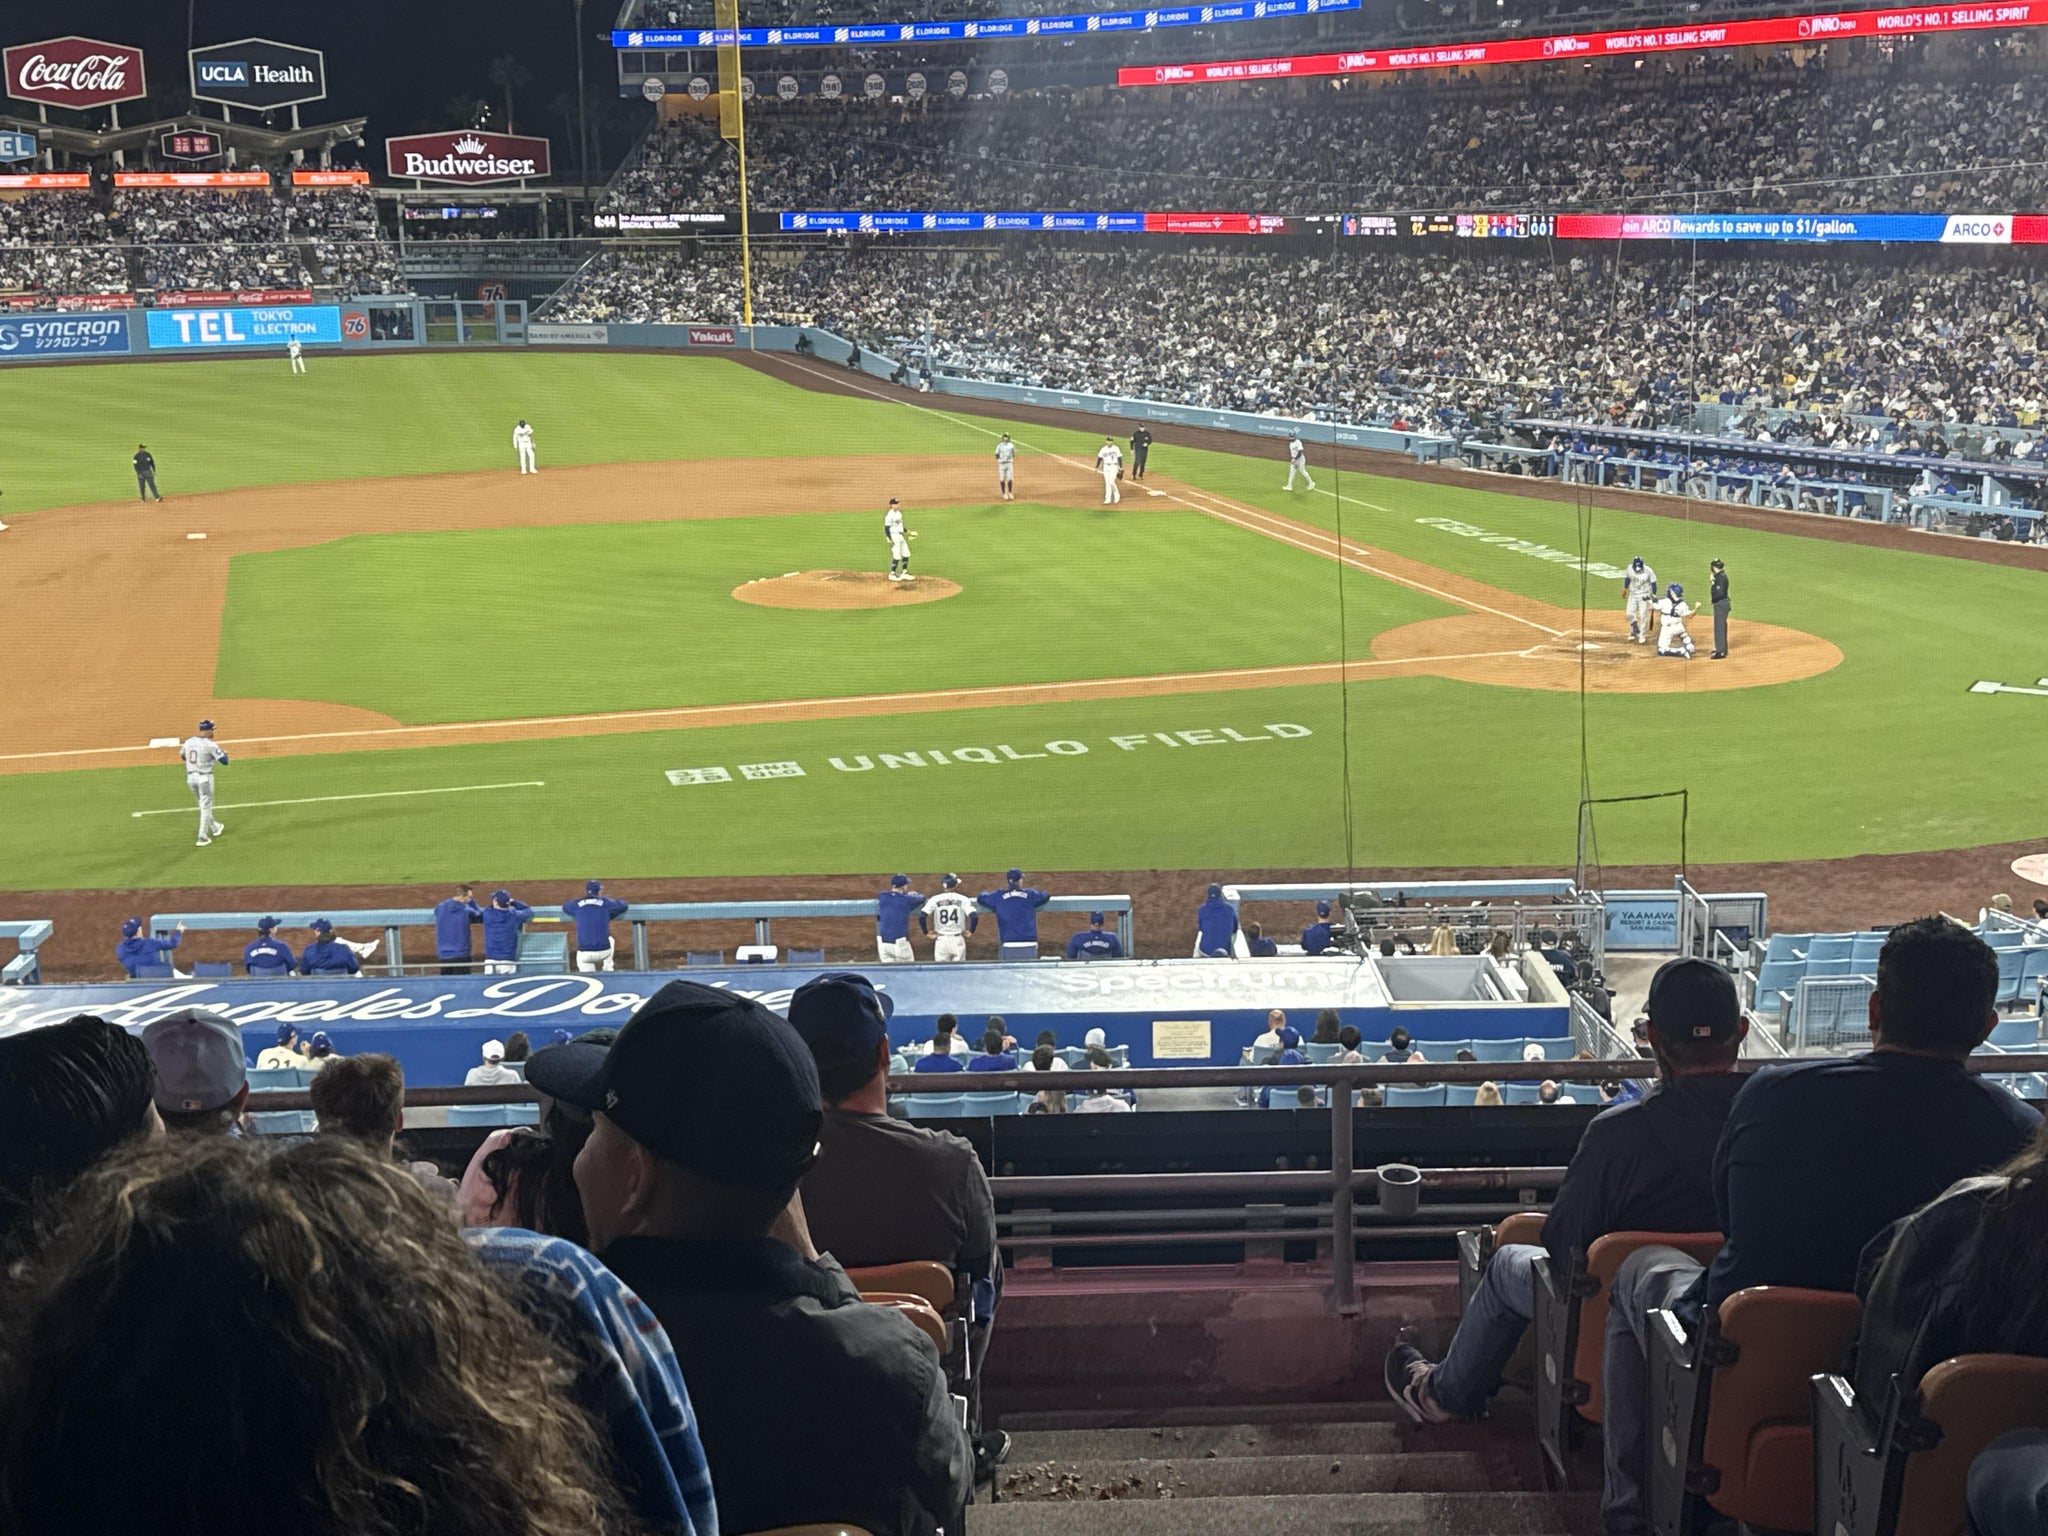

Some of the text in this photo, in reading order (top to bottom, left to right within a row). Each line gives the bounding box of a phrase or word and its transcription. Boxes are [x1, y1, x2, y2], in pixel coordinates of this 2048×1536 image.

[645, 34, 682, 42] ELDRIDGE
[851, 30, 886, 38] ELDRIDGE
[916, 27, 950, 36] ELDRIDGE
[980, 24, 1013, 33] ELDRIDGE
[1042, 21, 1074, 30] ELDRIDGE
[1101, 17, 1132, 26] ELDRIDGE
[1214, 7, 1243, 17] ELDRIDGE
[1877, 14, 1922, 29] WORLD'S
[1951, 9, 1993, 24] SELLING
[1995, 6, 2030, 21] SPIRIT
[19, 54, 129, 91] Coca-Cola
[201, 65, 314, 83] UCLA Health
[821, 81, 840, 91] 1981
[809, 217, 844, 225] ELDRIDGE
[875, 217, 908, 225] ELDRIDGE
[938, 217, 970, 225] ELDRIDGE
[998, 217, 1030, 226] ELDRIDGE
[1056, 218, 1085, 226] ELDRIDGE
[1642, 220, 1671, 233] ARCO
[1673, 220, 1720, 233] Rewards
[1723, 221, 1733, 233] to
[1736, 223, 1762, 233] save
[1765, 223, 1779, 236] up
[1782, 221, 1793, 233] to
[1796, 219, 1857, 237] $1/gallon.
[1953, 223, 1991, 236] ARCO
[252, 310, 293, 321] TOKYO
[20, 320, 120, 338] SYNCRON
[172, 312, 246, 343] TEL
[254, 323, 317, 335] ELECTRON
[347, 318, 365, 334] 76
[691, 331, 734, 343] Yakult
[828, 723, 1313, 772] UNIQLO FIELD
[939, 908, 959, 925] 84
[1061, 970, 1332, 995] Spectrum
